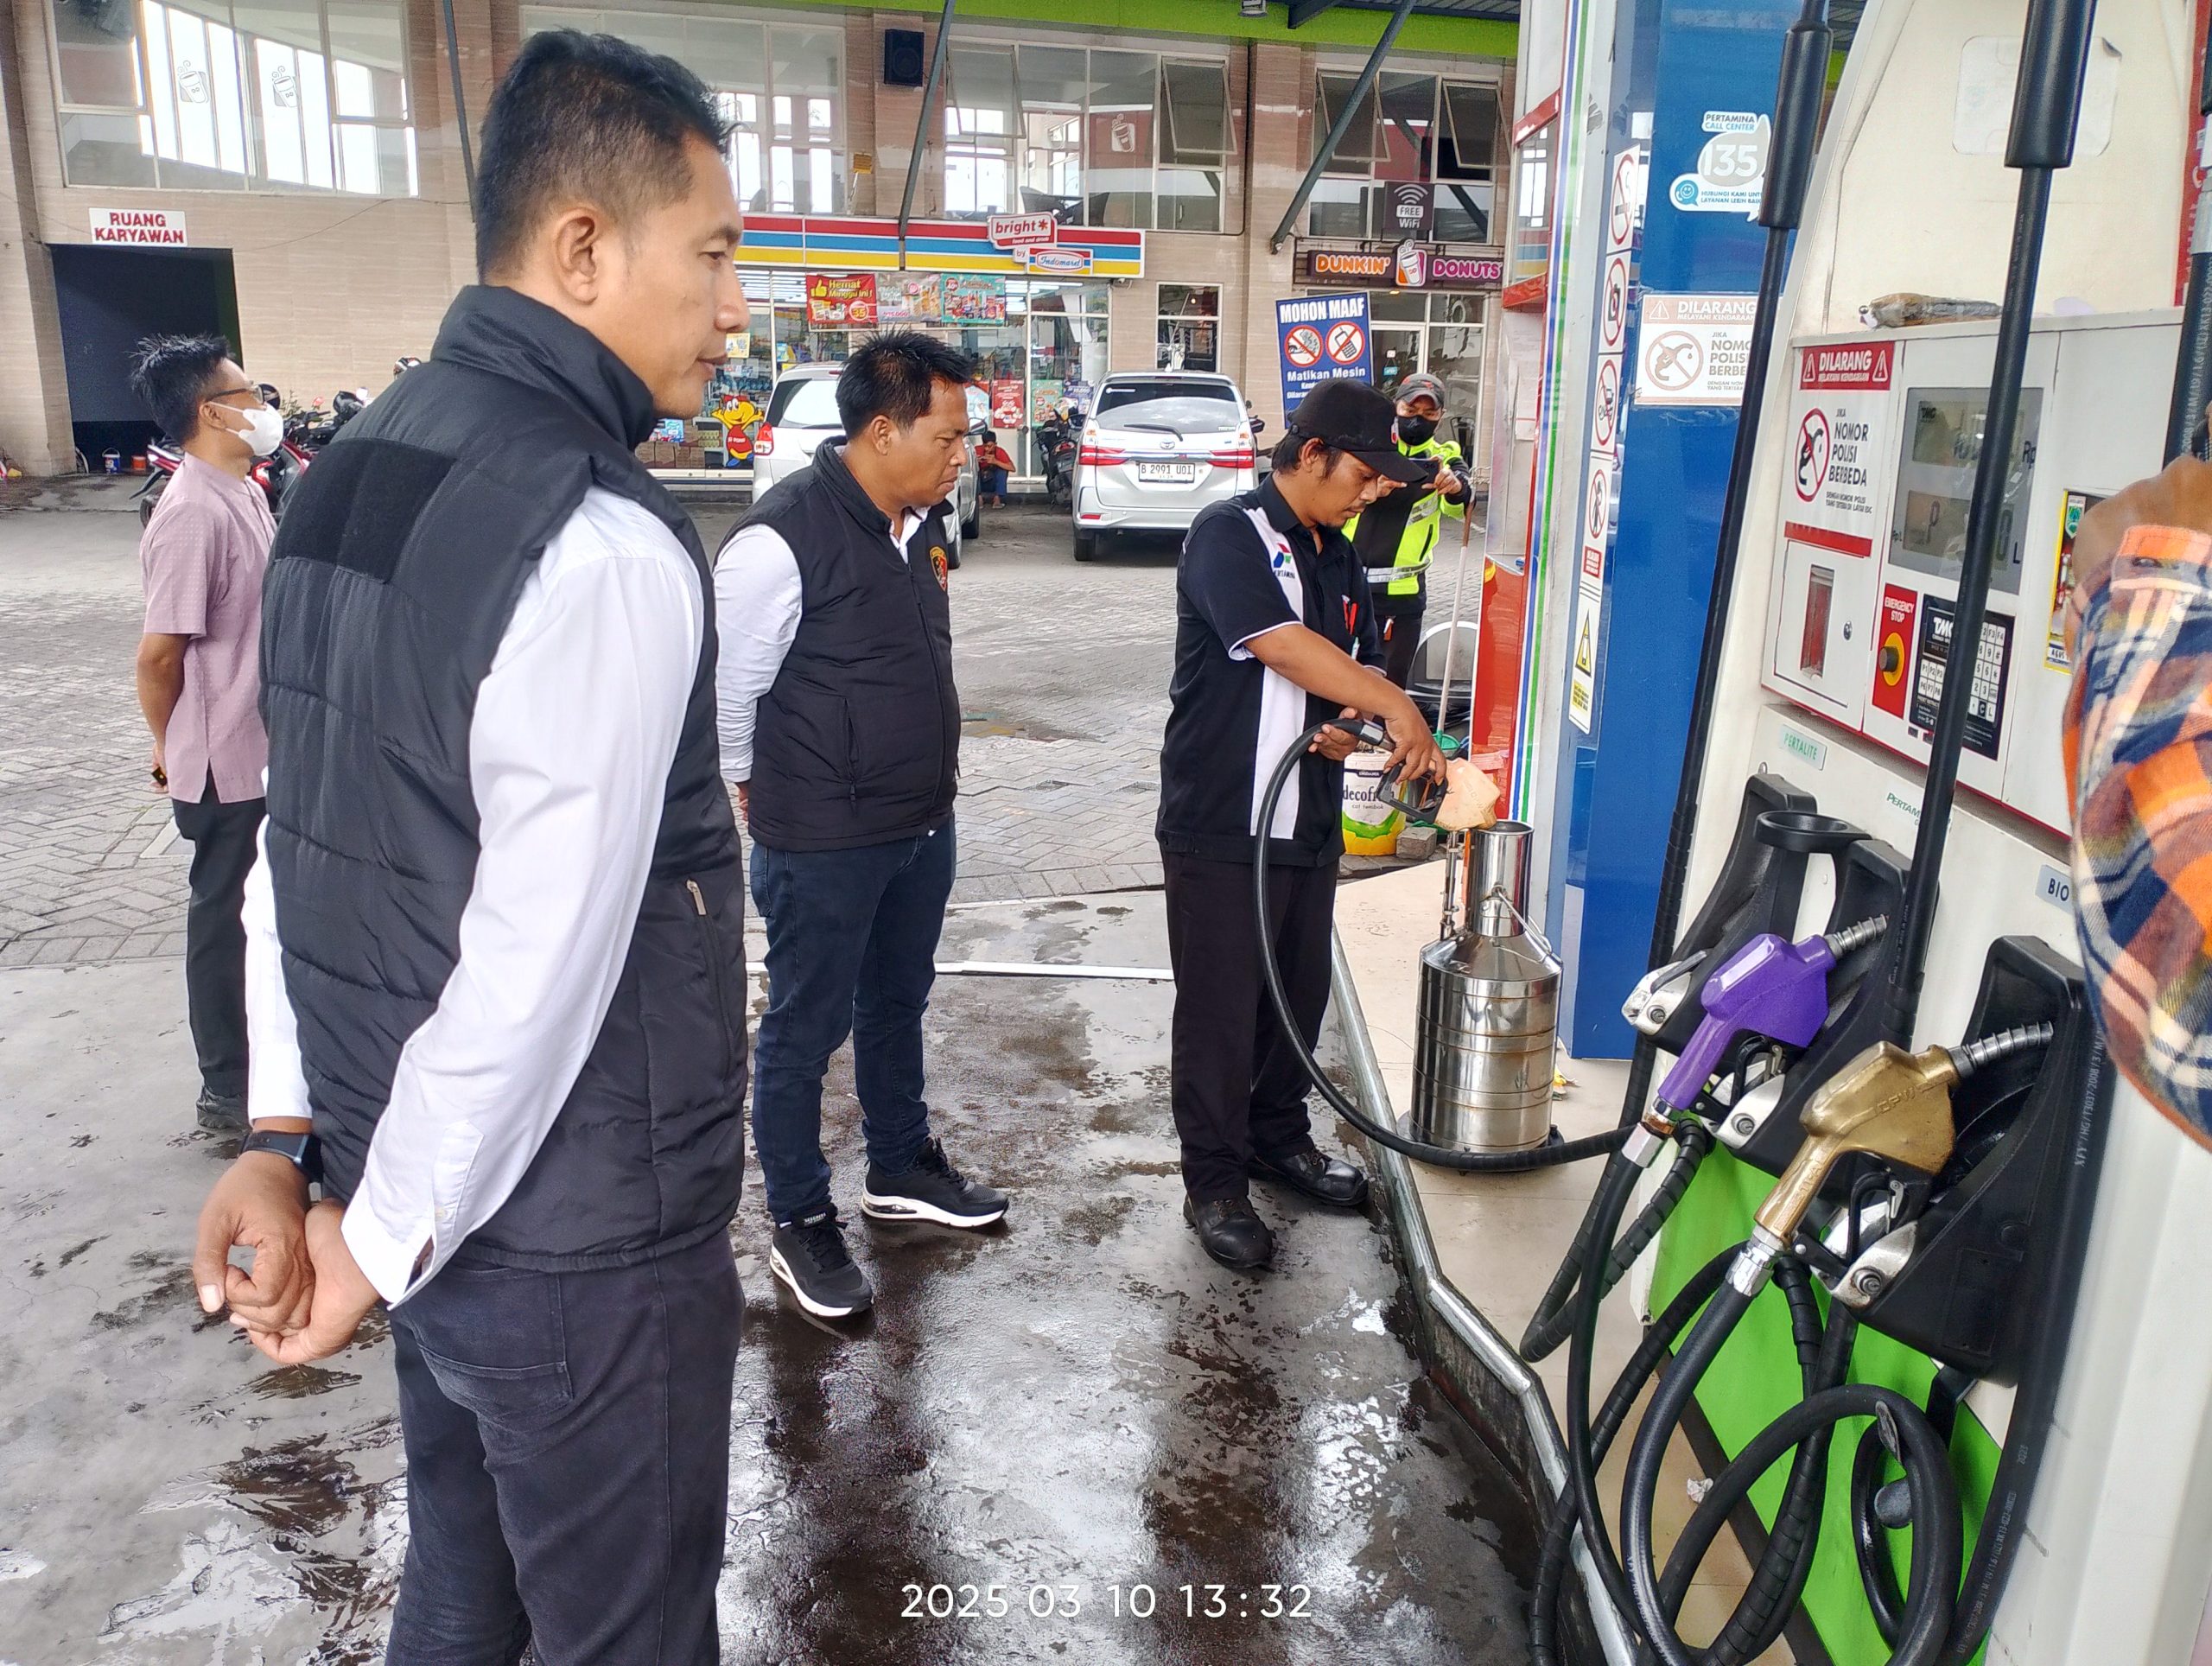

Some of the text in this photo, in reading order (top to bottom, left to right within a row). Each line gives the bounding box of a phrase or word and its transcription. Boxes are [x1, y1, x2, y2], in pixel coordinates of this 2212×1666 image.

[1706, 114, 1755, 124] PERTAMINA
[1703, 144, 1758, 177] 135
[109, 212, 166, 226] RUANG
[1400, 207, 1421, 216] FREE
[995, 219, 1037, 235] bright
[1398, 218, 1421, 229] WiFi
[94, 227, 184, 243] KARYAWAN
[1039, 256, 1081, 267] Indomaret
[1315, 254, 1392, 275] DUNKIN'
[829, 279, 861, 289] Hemat
[829, 289, 858, 299] Minggu
[853, 308, 867, 318] 35
[1280, 296, 1365, 324] MOHON MAAF
[1677, 301, 1757, 315] DILARANG
[1818, 349, 1872, 372] DILARANG
[1287, 366, 1366, 382] Matikan Mesin
[1708, 365, 1747, 377] BERBE
[1836, 408, 1847, 418] JIKA
[1834, 422, 1870, 442] NOMOR
[1831, 443, 1858, 464] POLISI
[2023, 440, 2037, 470] Rp
[1141, 464, 1147, 474] B
[1149, 464, 1172, 474] 2991
[1828, 465, 1867, 487] BERBEDA
[2012, 541, 2021, 565] L
[1884, 596, 1915, 614] EMERGENCY
[1891, 609, 1905, 623] STOP
[1988, 629, 1996, 639] F3
[1996, 630, 2005, 641] F4
[1922, 663, 1929, 672] P1
[1929, 665, 1936, 676] P2
[1783, 732, 1818, 760] PERTALITE
[1886, 792, 1921, 818] PERTAM
[2048, 877, 2070, 902] BIO
